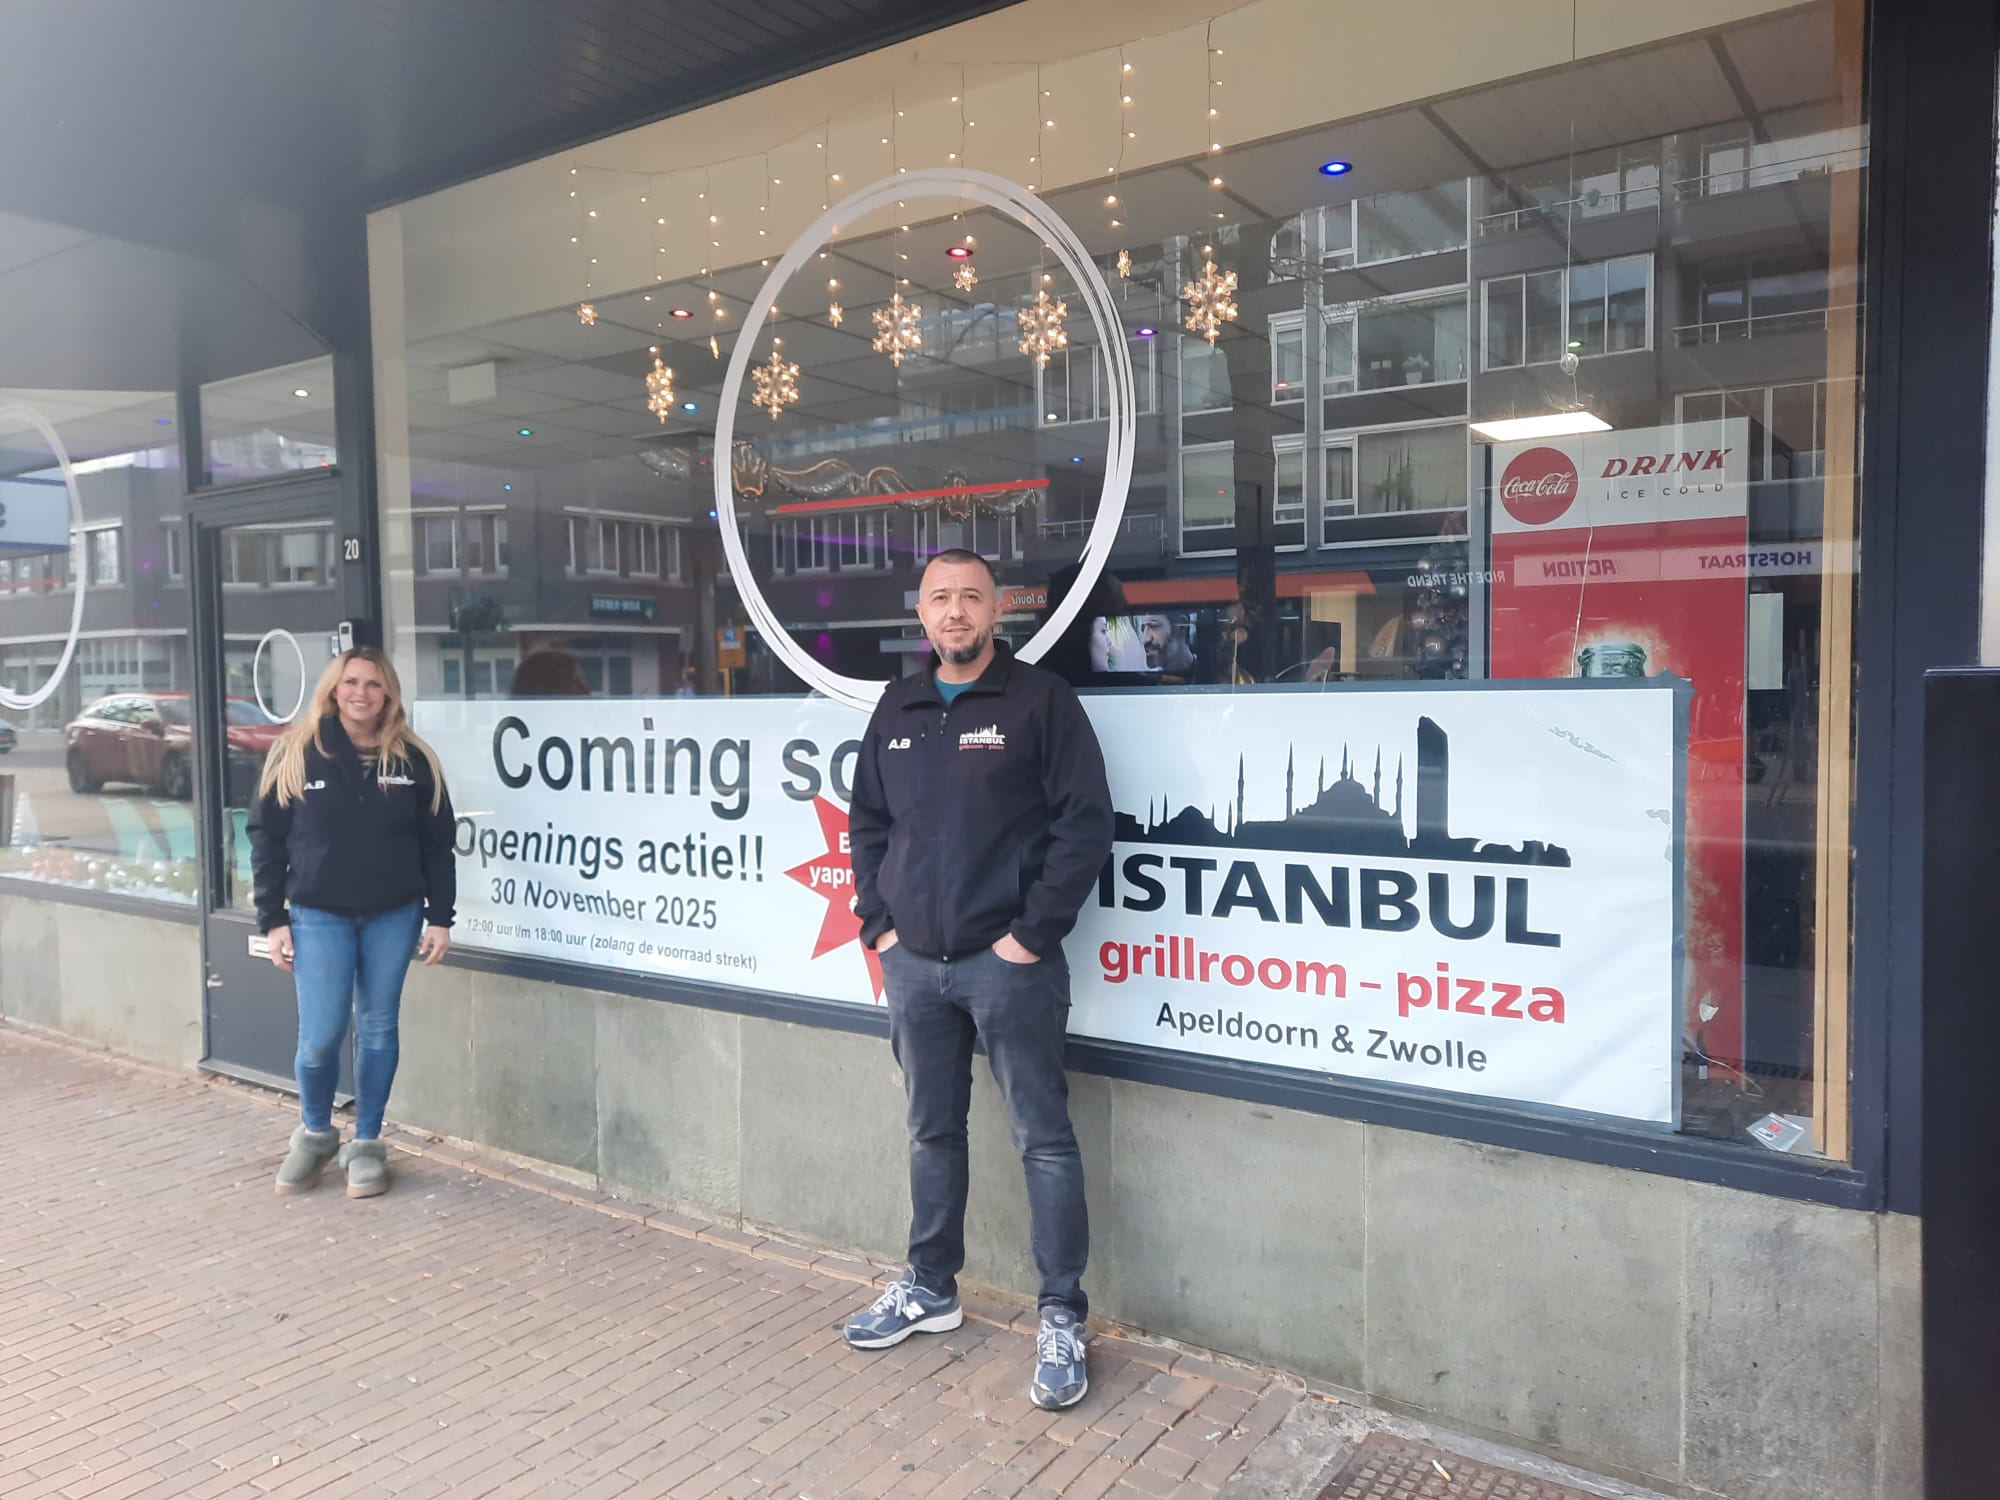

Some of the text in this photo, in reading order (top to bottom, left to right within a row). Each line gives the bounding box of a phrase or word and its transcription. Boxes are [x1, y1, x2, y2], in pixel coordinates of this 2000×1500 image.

[1503, 471, 1575, 499] Coca-Cola
[1599, 448, 1733, 479] DRINK
[1606, 483, 1724, 501] ICE COLD
[344, 538, 360, 561] 20
[959, 737, 1005, 745] ISTANBUL
[492, 715, 864, 821] Coming so
[454, 816, 764, 883] Openings actie!!
[808, 865, 856, 889] yapr
[1099, 852, 1562, 948] ISTANBUL
[490, 878, 718, 930] 30 November 2025
[466, 917, 494, 934] 12:00
[496, 923, 514, 936] uur
[534, 926, 563, 944] 18:00
[565, 933, 588, 947] uur
[590, 933, 635, 956] (zolang
[638, 939, 654, 956] de
[657, 944, 712, 964] voorraad
[715, 952, 758, 974] strekt)
[1099, 934, 1347, 999] grillroom
[1397, 962, 1566, 1025] pizza
[1155, 1002, 1488, 1073] Apeldoorn & Zwolle
